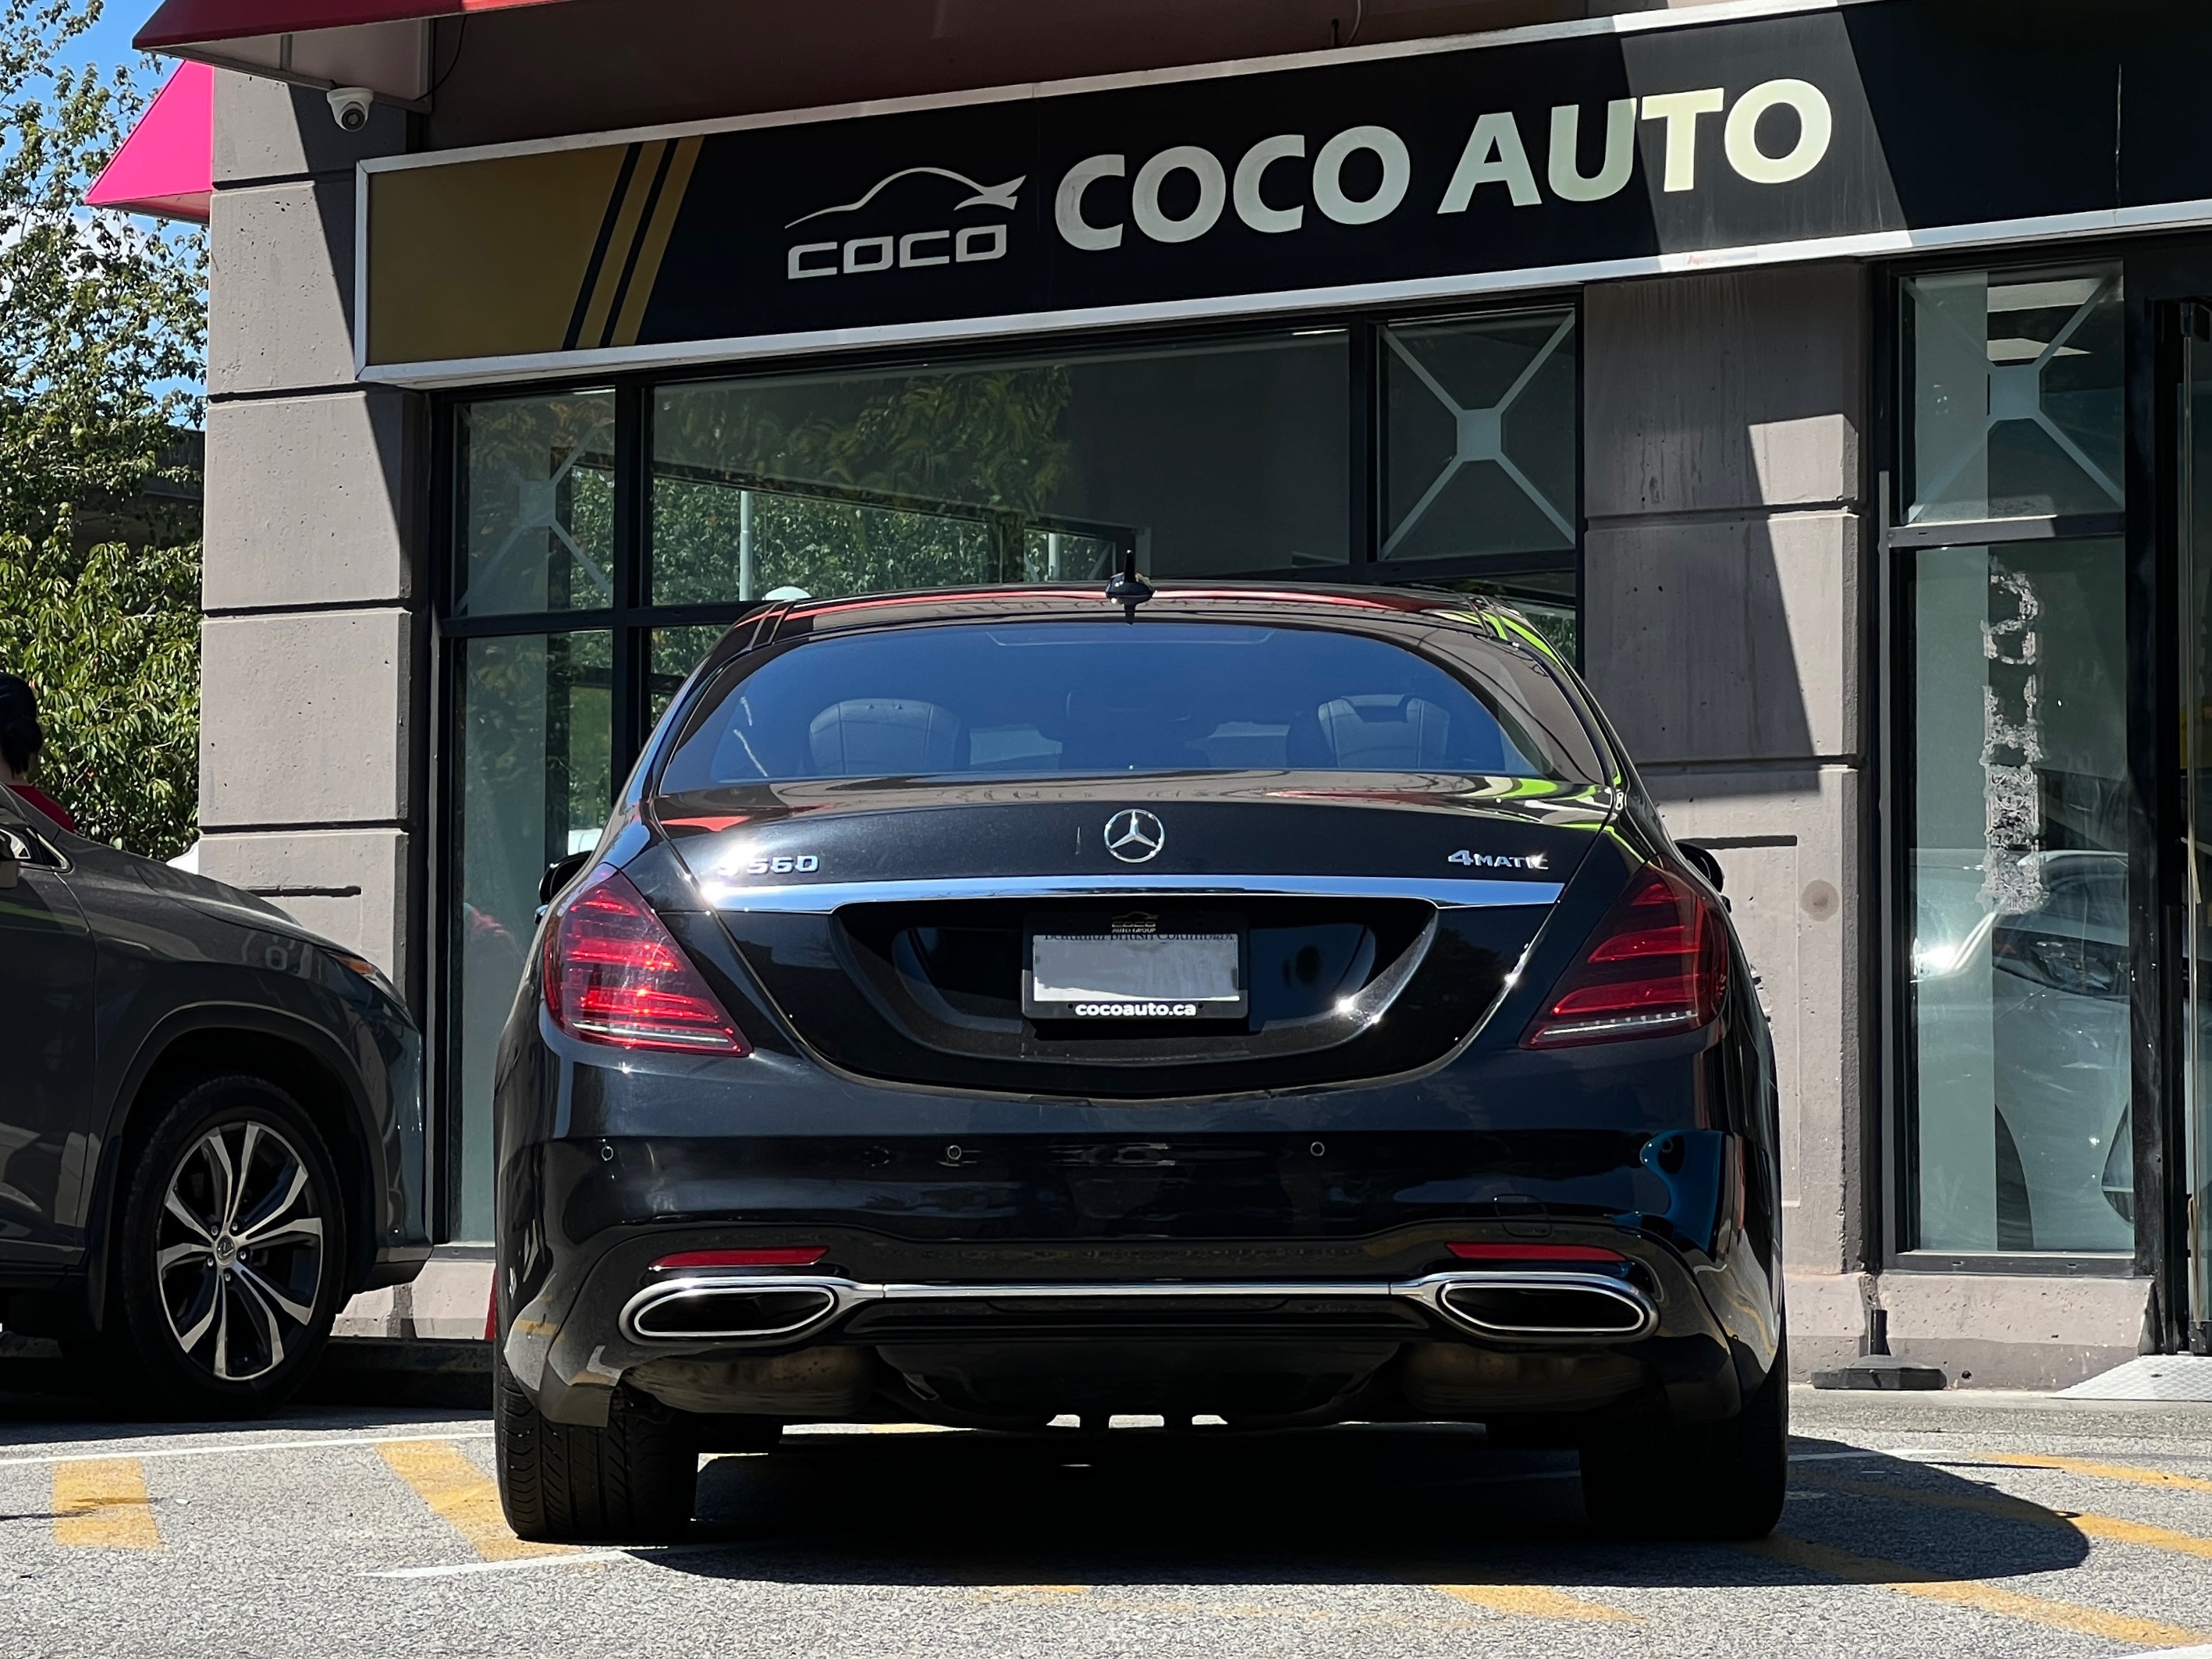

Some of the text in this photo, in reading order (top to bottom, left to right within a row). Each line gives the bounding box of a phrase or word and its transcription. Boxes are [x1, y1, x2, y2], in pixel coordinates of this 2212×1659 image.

[1055, 78, 1833, 250] COCO AUTO
[787, 223, 1007, 279] COCO
[1447, 850, 1549, 869] 4MATIC
[1074, 1002, 1197, 1016] cocoauto.ca
